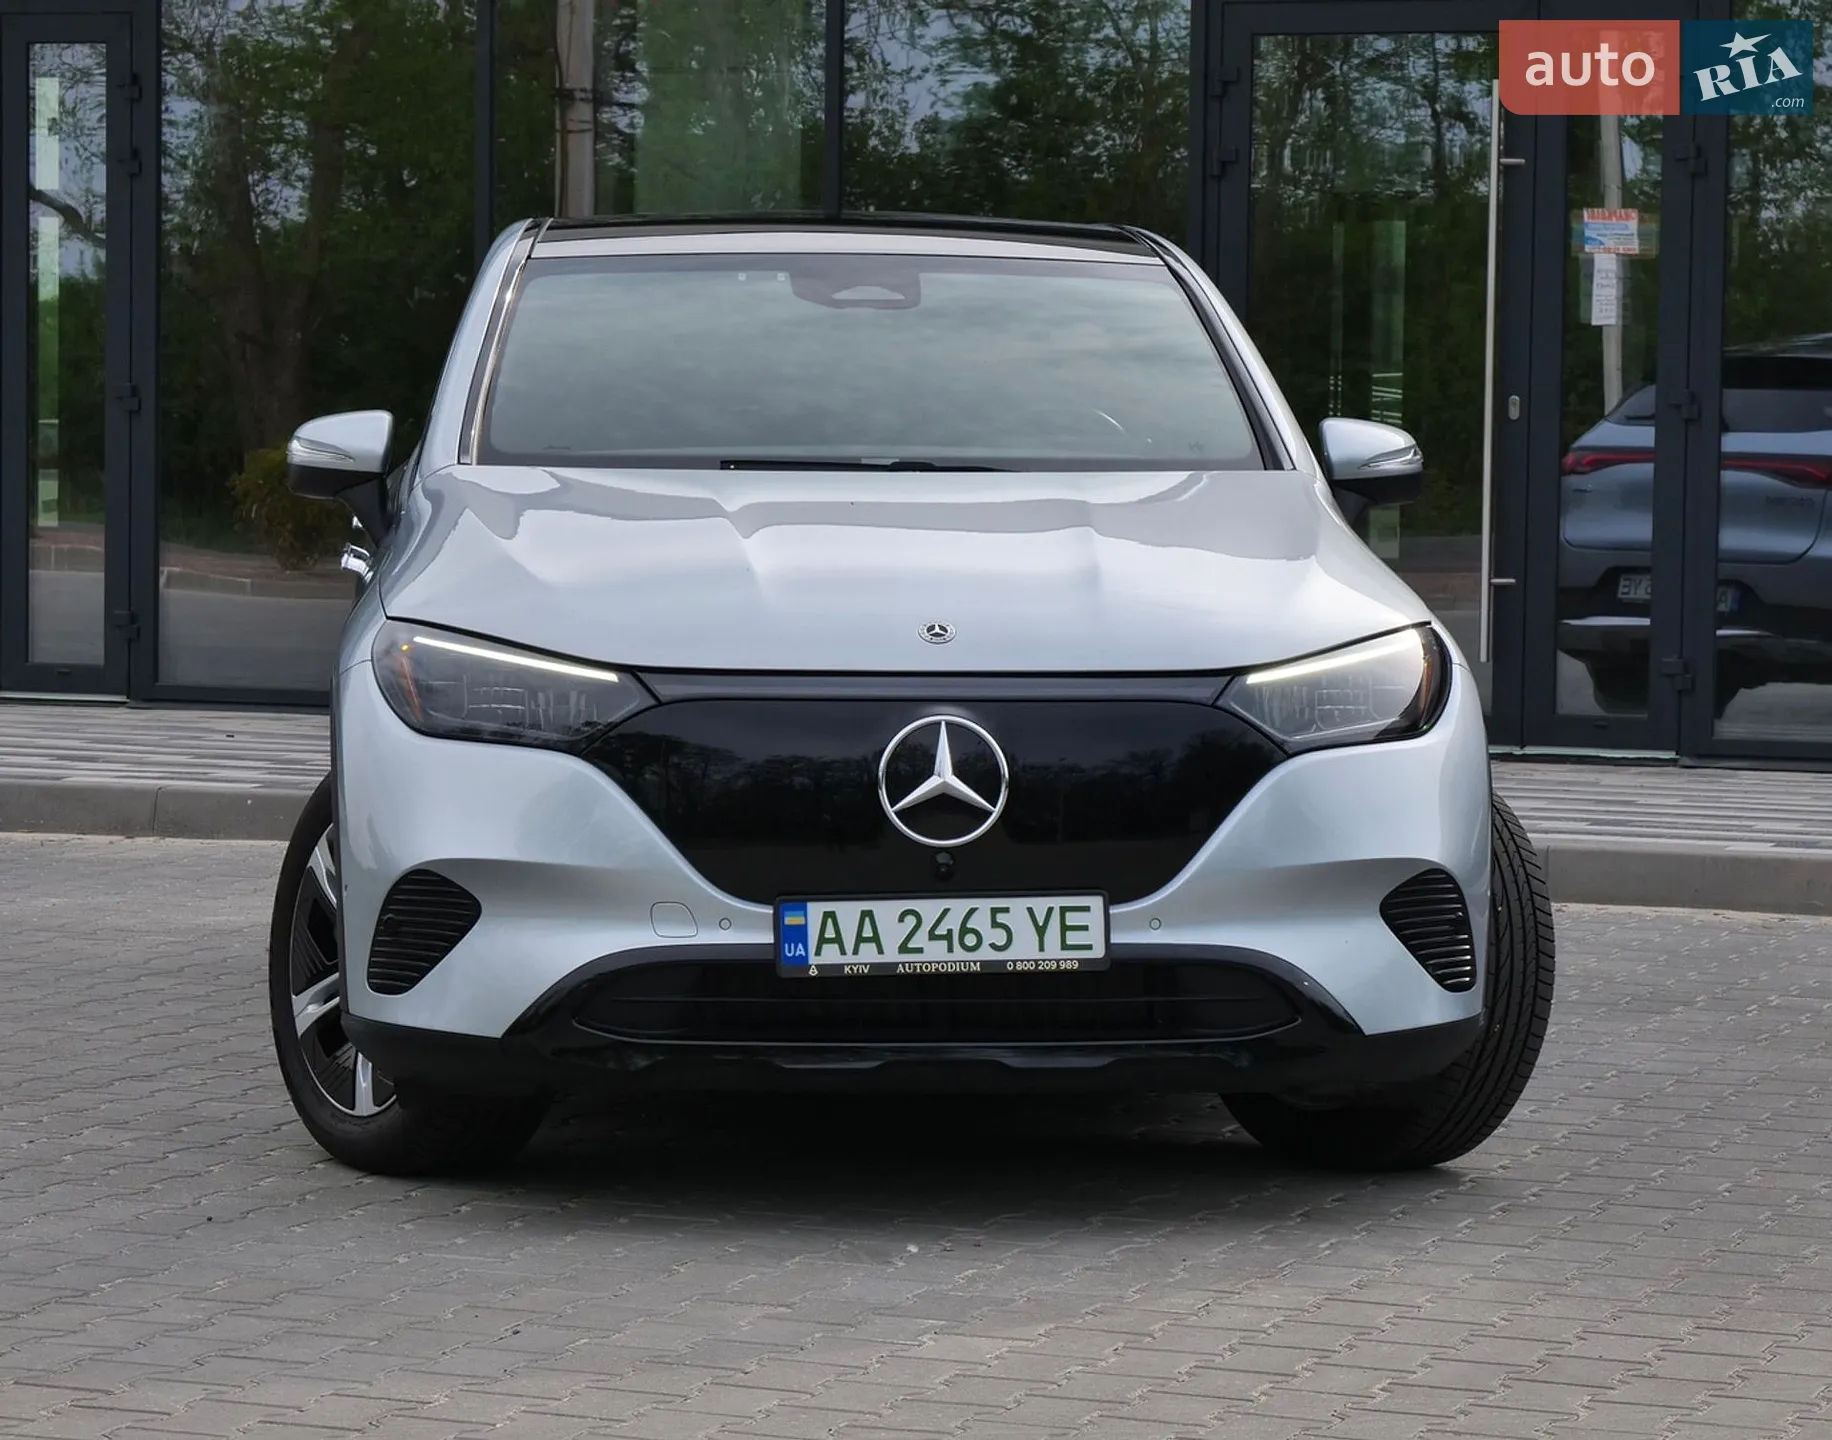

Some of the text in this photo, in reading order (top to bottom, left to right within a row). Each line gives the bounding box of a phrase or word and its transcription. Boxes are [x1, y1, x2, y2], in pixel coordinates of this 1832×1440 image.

[814, 905, 1094, 957] AA 2465 YE
[784, 943, 806, 957] UA
[843, 960, 1079, 975] KYIV AUTOPODIUM 0 800 209 989
